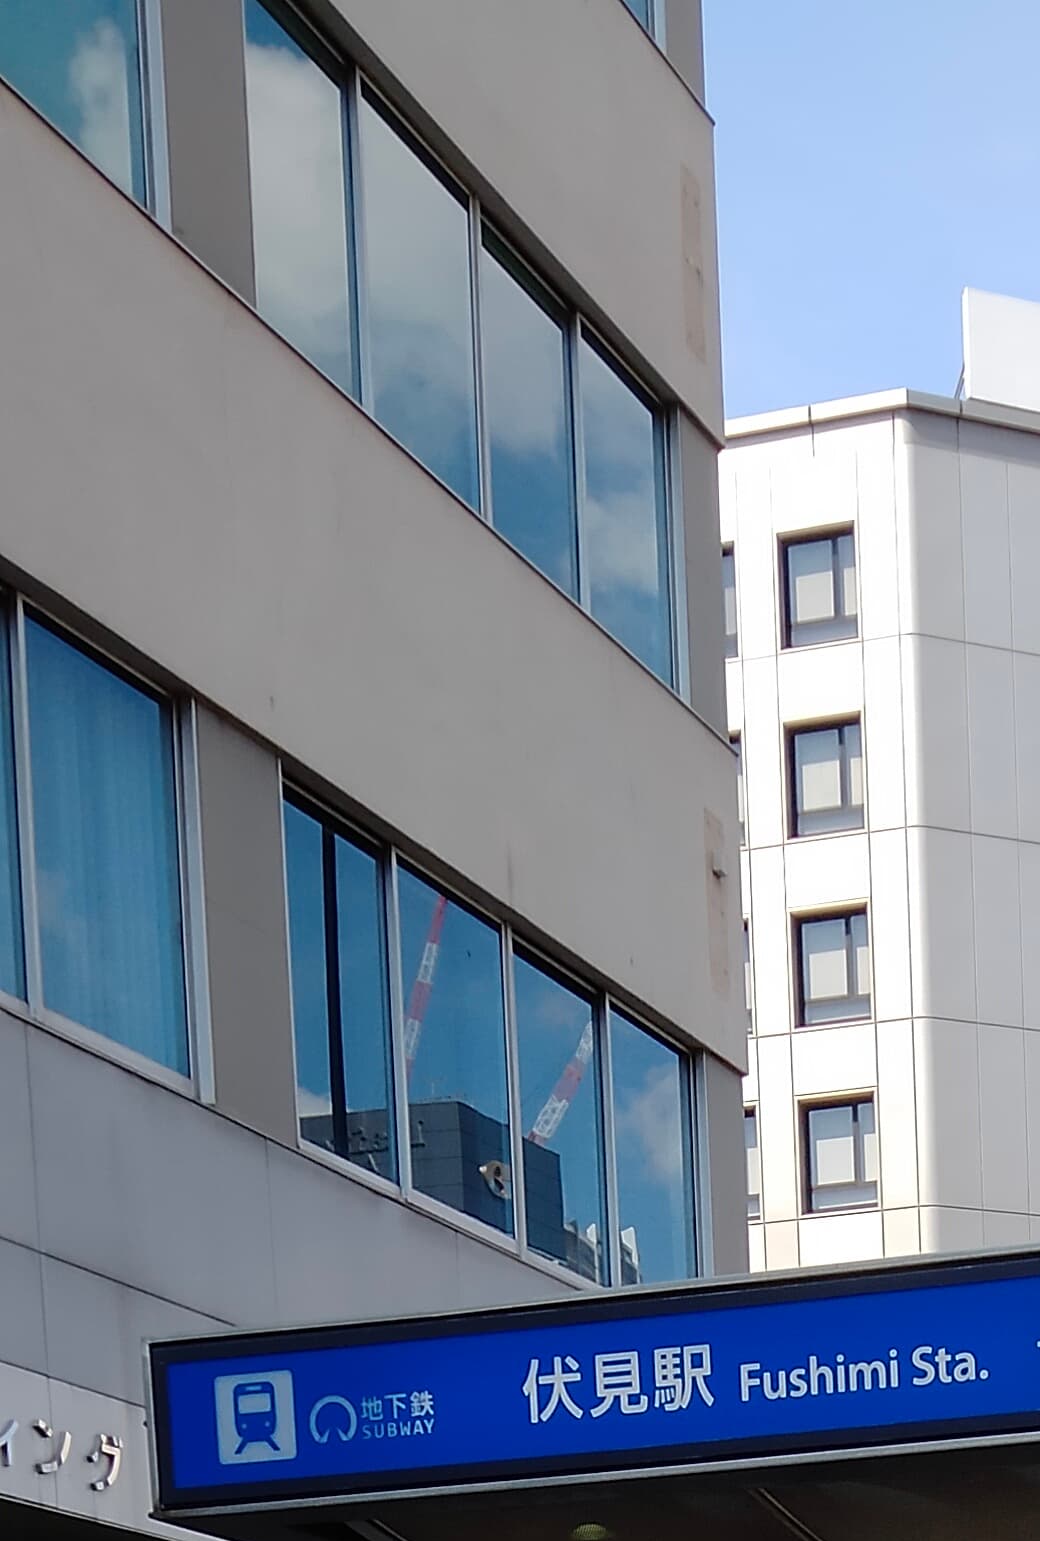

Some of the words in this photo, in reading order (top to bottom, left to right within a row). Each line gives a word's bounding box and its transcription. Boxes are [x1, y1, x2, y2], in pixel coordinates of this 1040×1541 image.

[522, 1344, 715, 1423] 伏見駅
[740, 1349, 900, 1402] Fushimi
[911, 1346, 990, 1386] Sta.
[361, 1390, 435, 1421] 地下鉄
[362, 1418, 435, 1440] SUBWAY
